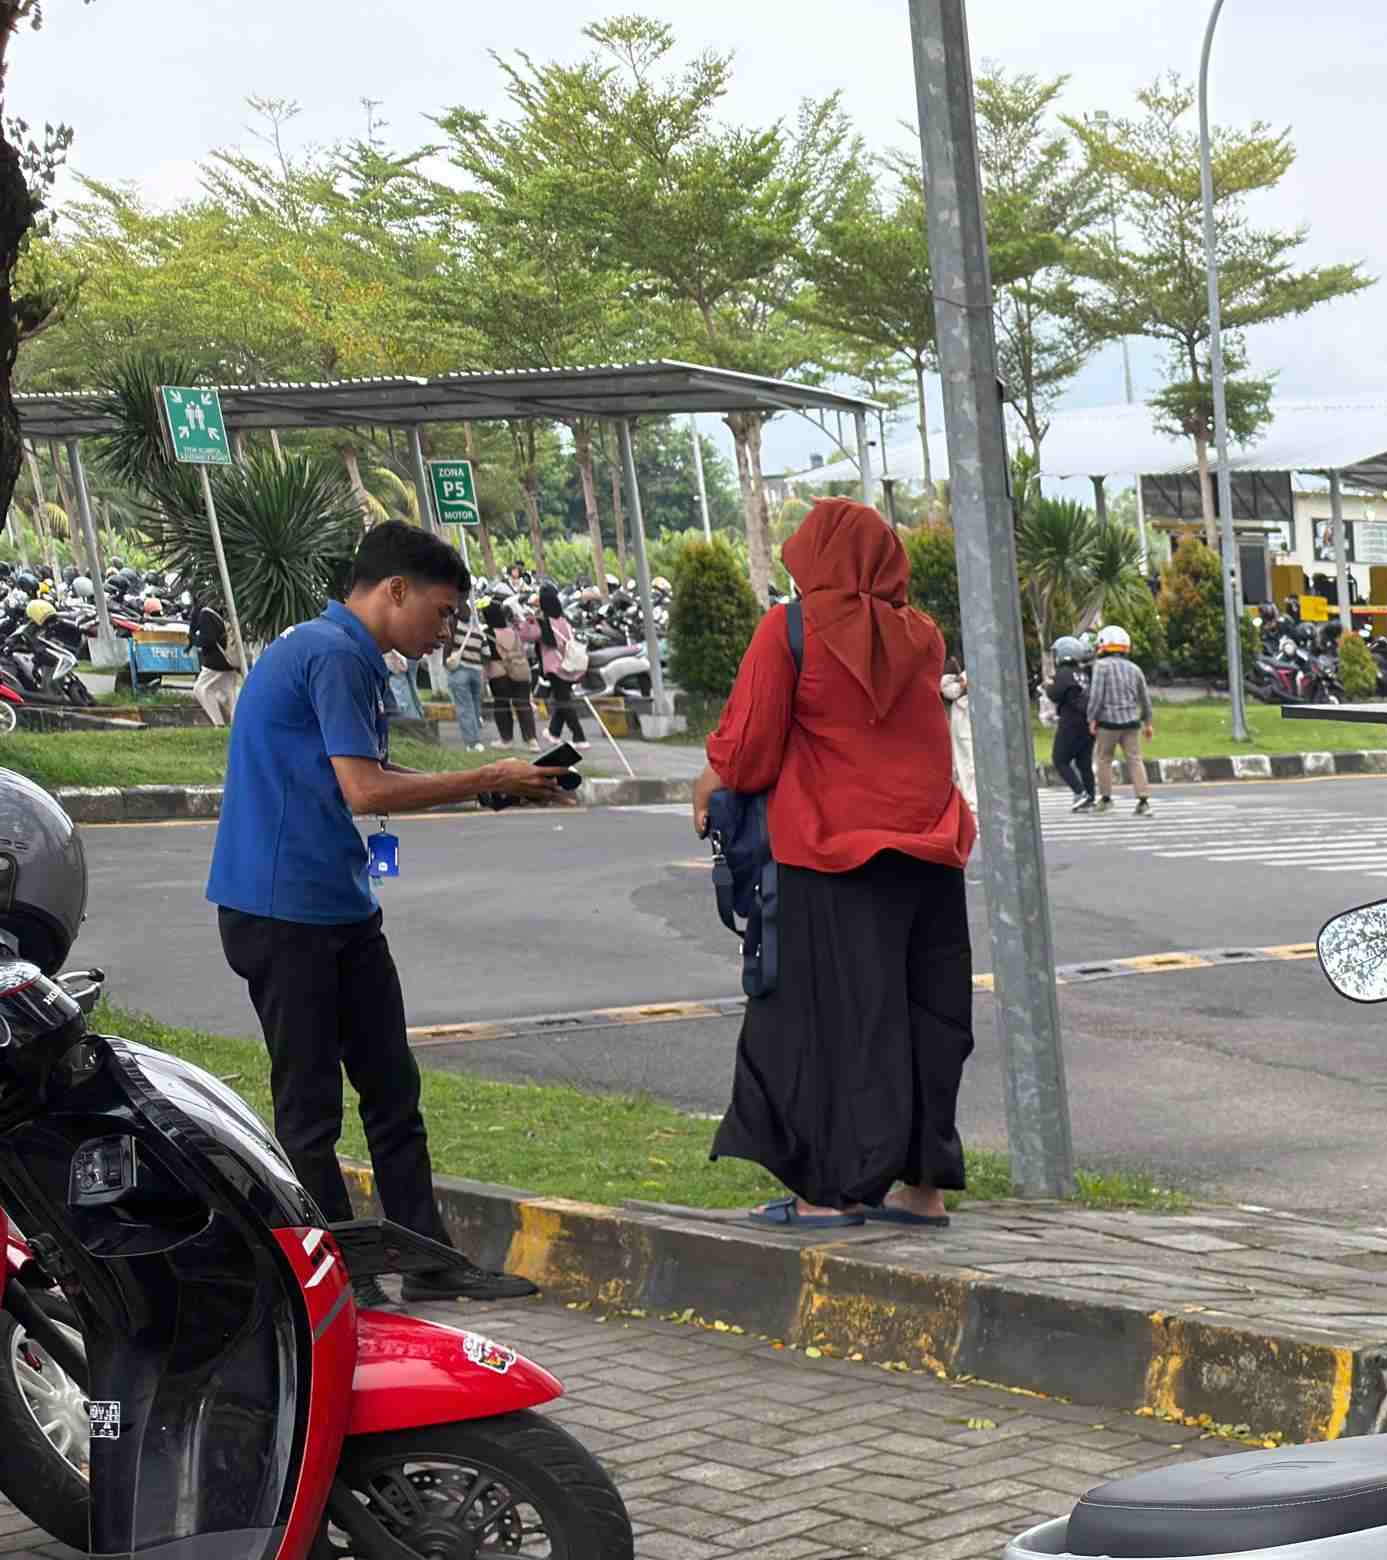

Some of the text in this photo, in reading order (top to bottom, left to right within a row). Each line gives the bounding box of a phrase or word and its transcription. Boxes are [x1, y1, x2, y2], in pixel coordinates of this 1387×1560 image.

[439, 467, 465, 478] ZONA
[442, 480, 465, 498] P5
[444, 510, 474, 521] MOTOR
